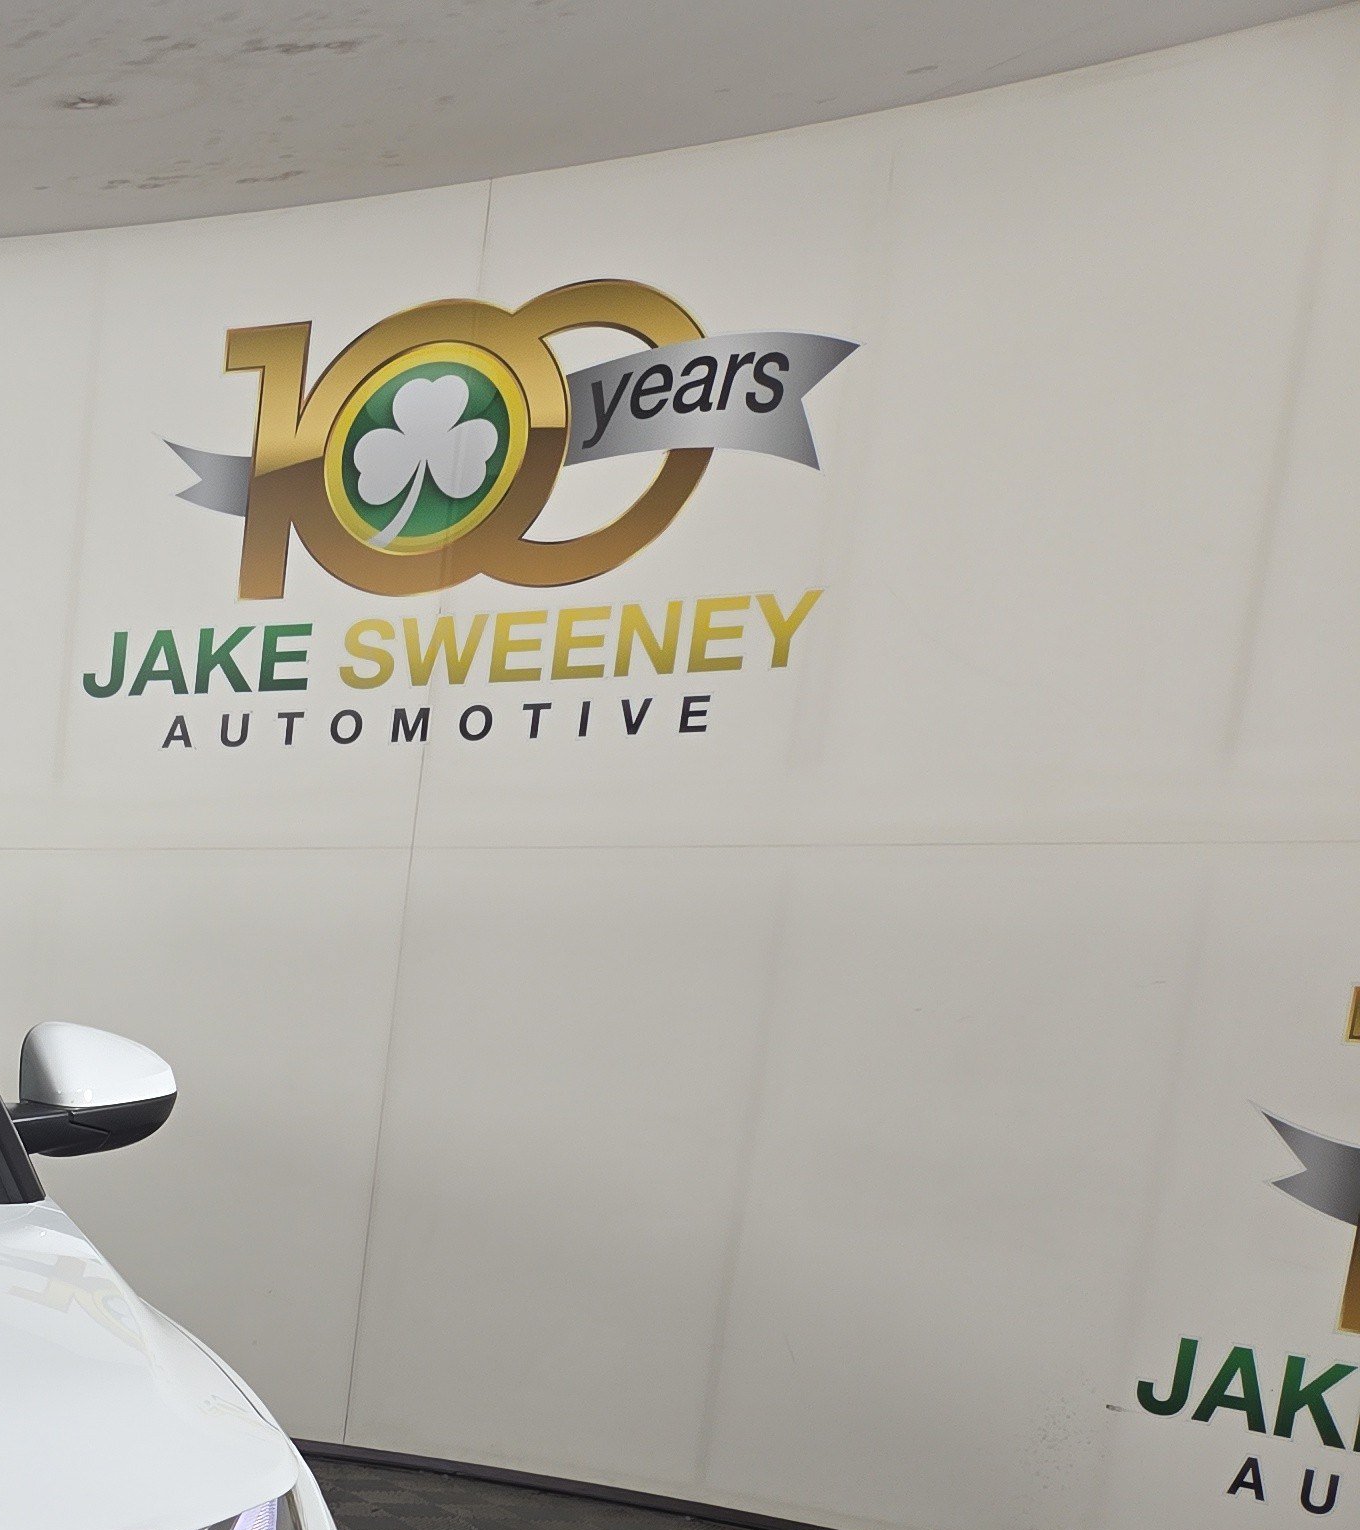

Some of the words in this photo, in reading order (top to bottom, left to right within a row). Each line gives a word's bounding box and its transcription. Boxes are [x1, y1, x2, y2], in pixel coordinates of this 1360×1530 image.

[224, 278, 716, 600] 100
[581, 350, 791, 451] years
[81, 623, 314, 699] JAKE
[338, 589, 826, 690] SWEENEY
[161, 695, 712, 749] AUTOMOTIVE
[1136, 1337, 1360, 1453] JAK
